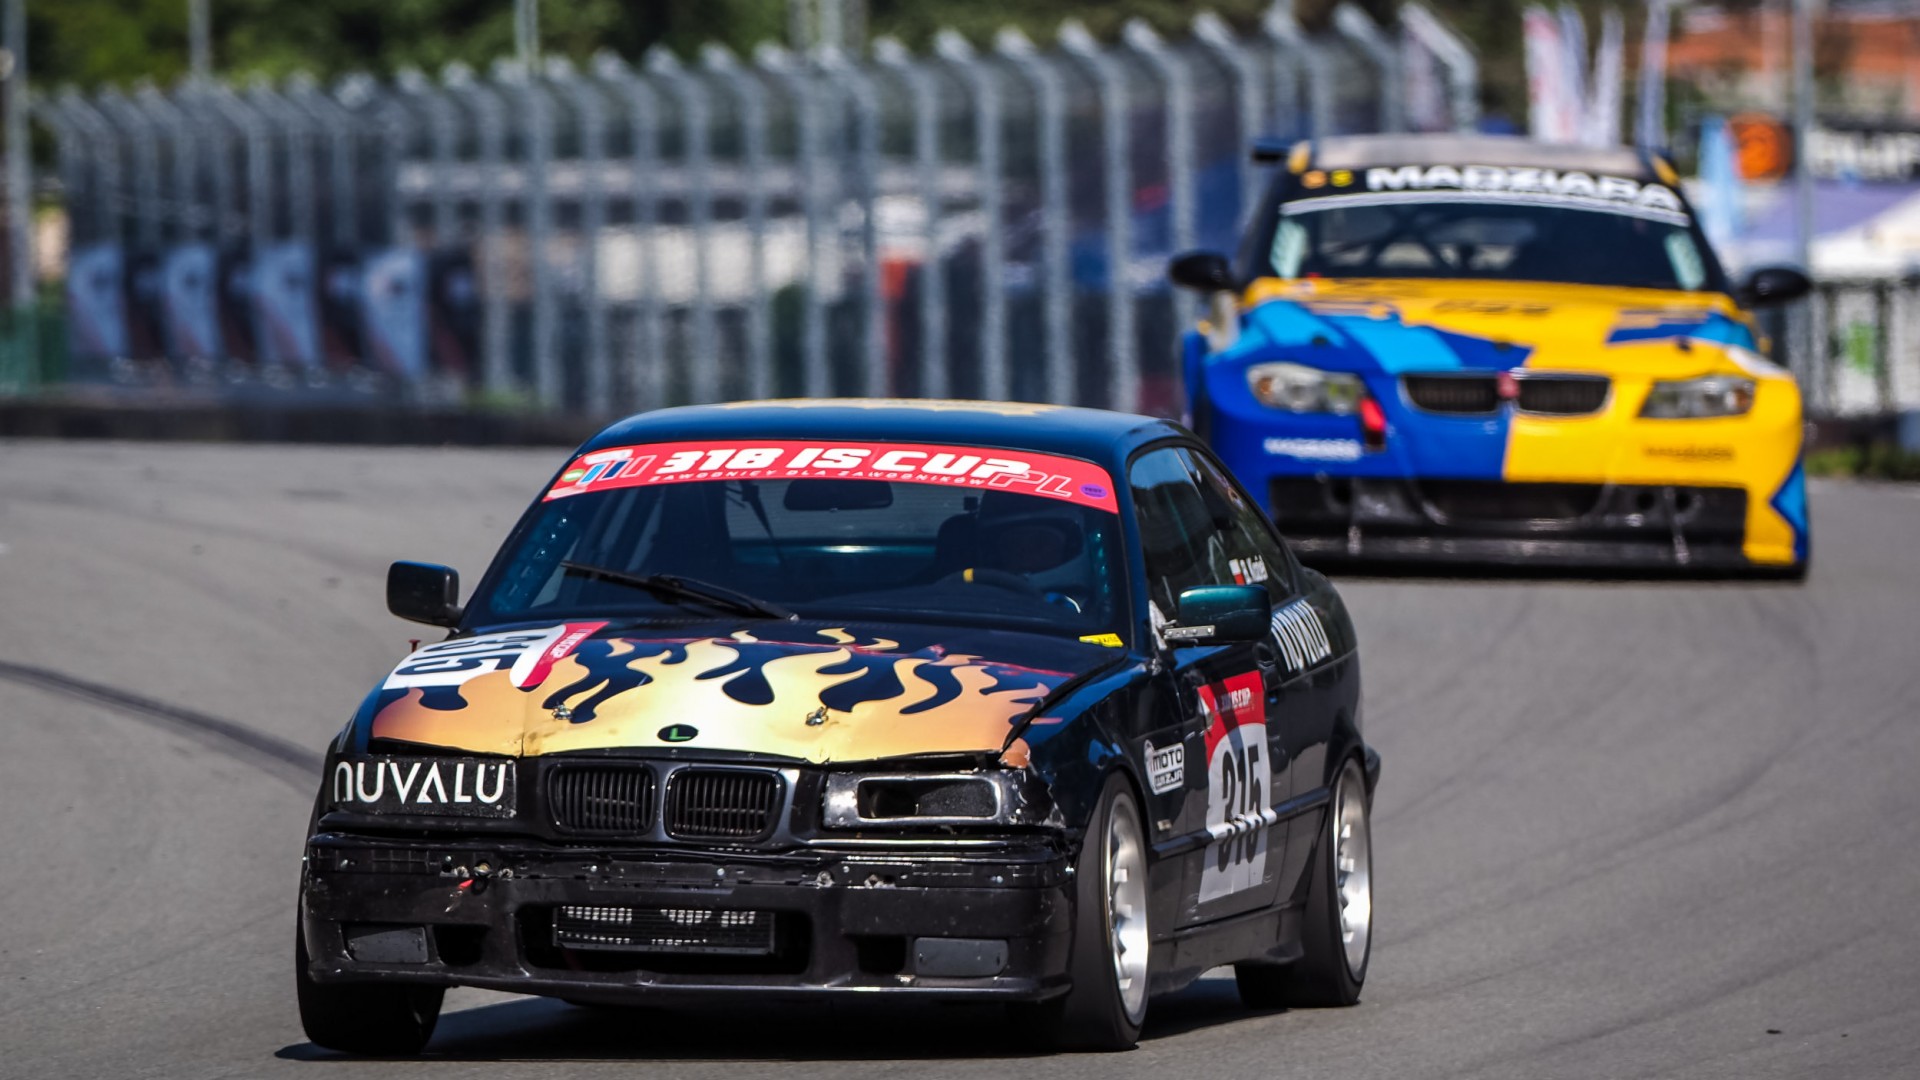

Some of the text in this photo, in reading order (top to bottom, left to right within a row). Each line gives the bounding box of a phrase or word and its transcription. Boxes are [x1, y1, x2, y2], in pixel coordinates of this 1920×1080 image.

[655, 448, 785, 475] 318
[785, 447, 872, 470] IS
[871, 450, 1031, 480] CUP
[988, 470, 1073, 498] PL
[1152, 748, 1183, 772] MOTO
[1217, 743, 1266, 873] 315
